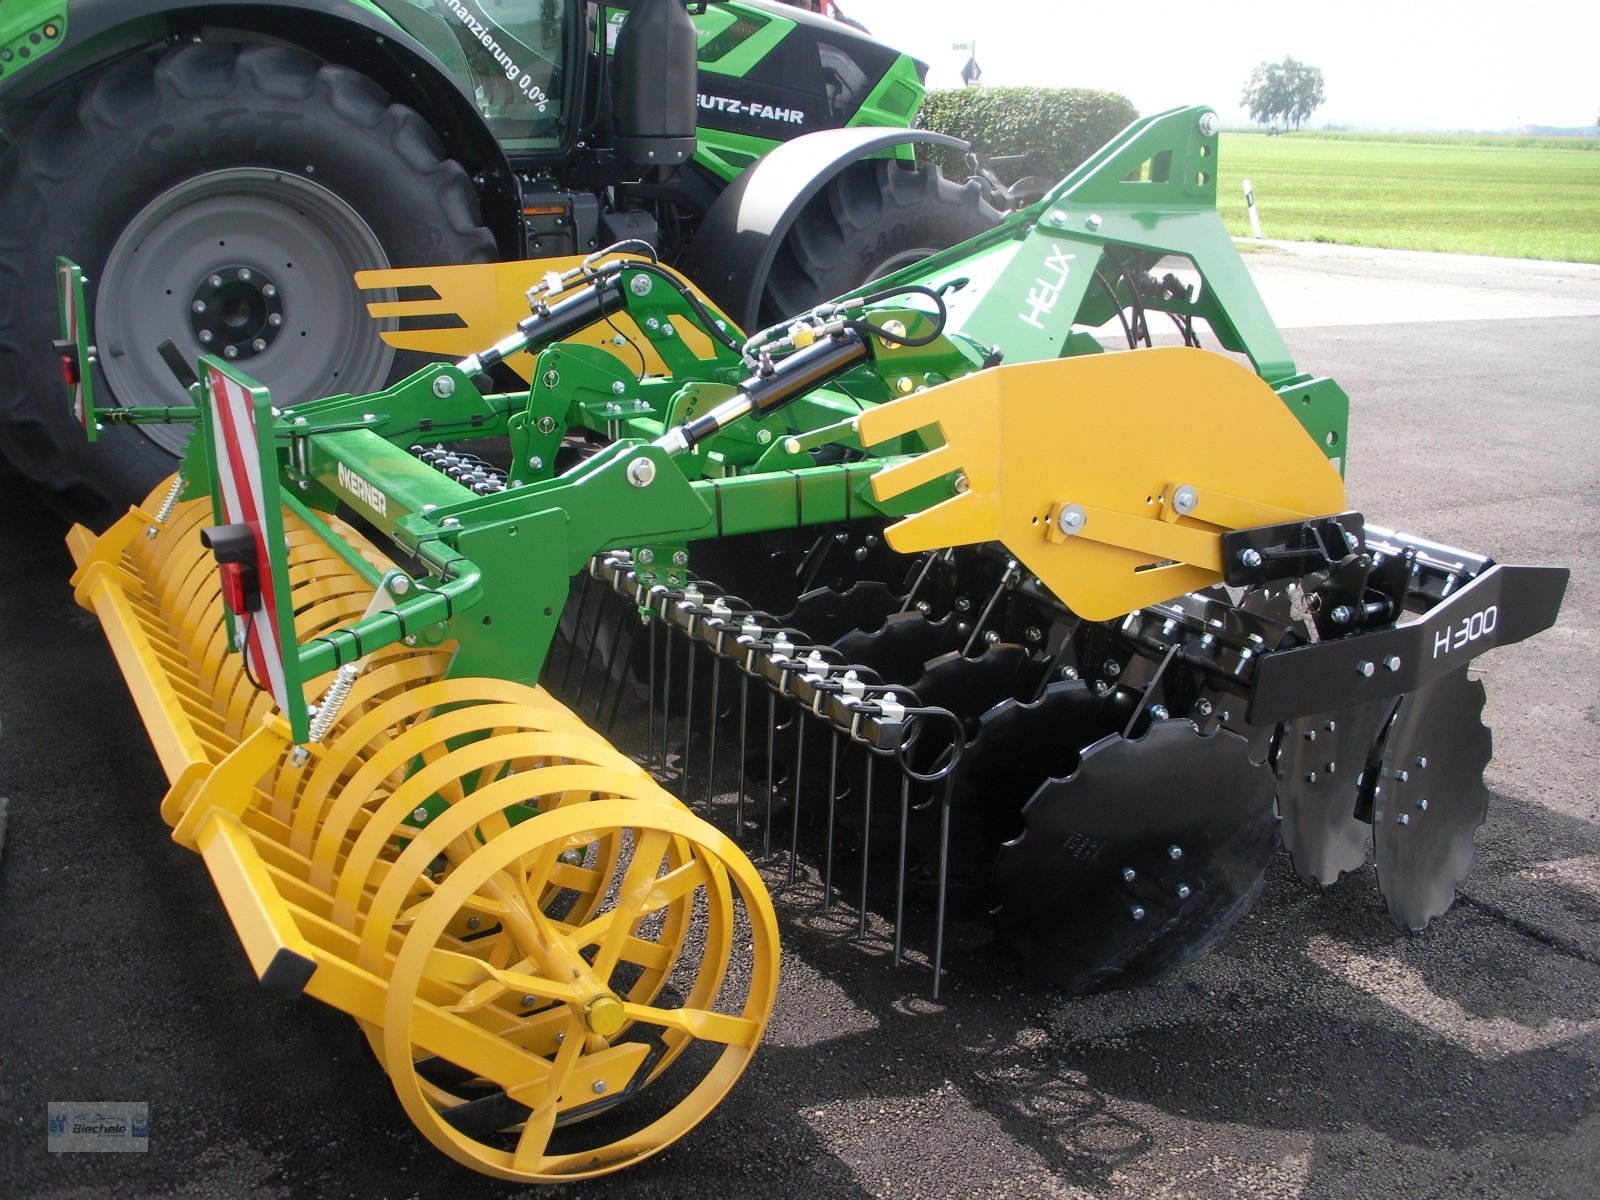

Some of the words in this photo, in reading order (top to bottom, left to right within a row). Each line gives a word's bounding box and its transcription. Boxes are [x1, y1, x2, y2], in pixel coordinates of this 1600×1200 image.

[443, 0, 520, 80] nanzierung
[518, 73, 549, 112] 0,0%
[697, 93, 804, 124] UTZ-FAHR
[1018, 243, 1076, 329] HELIX
[343, 465, 387, 518] KERNER
[1433, 625, 1451, 659] H
[1453, 605, 1498, 649] 300
